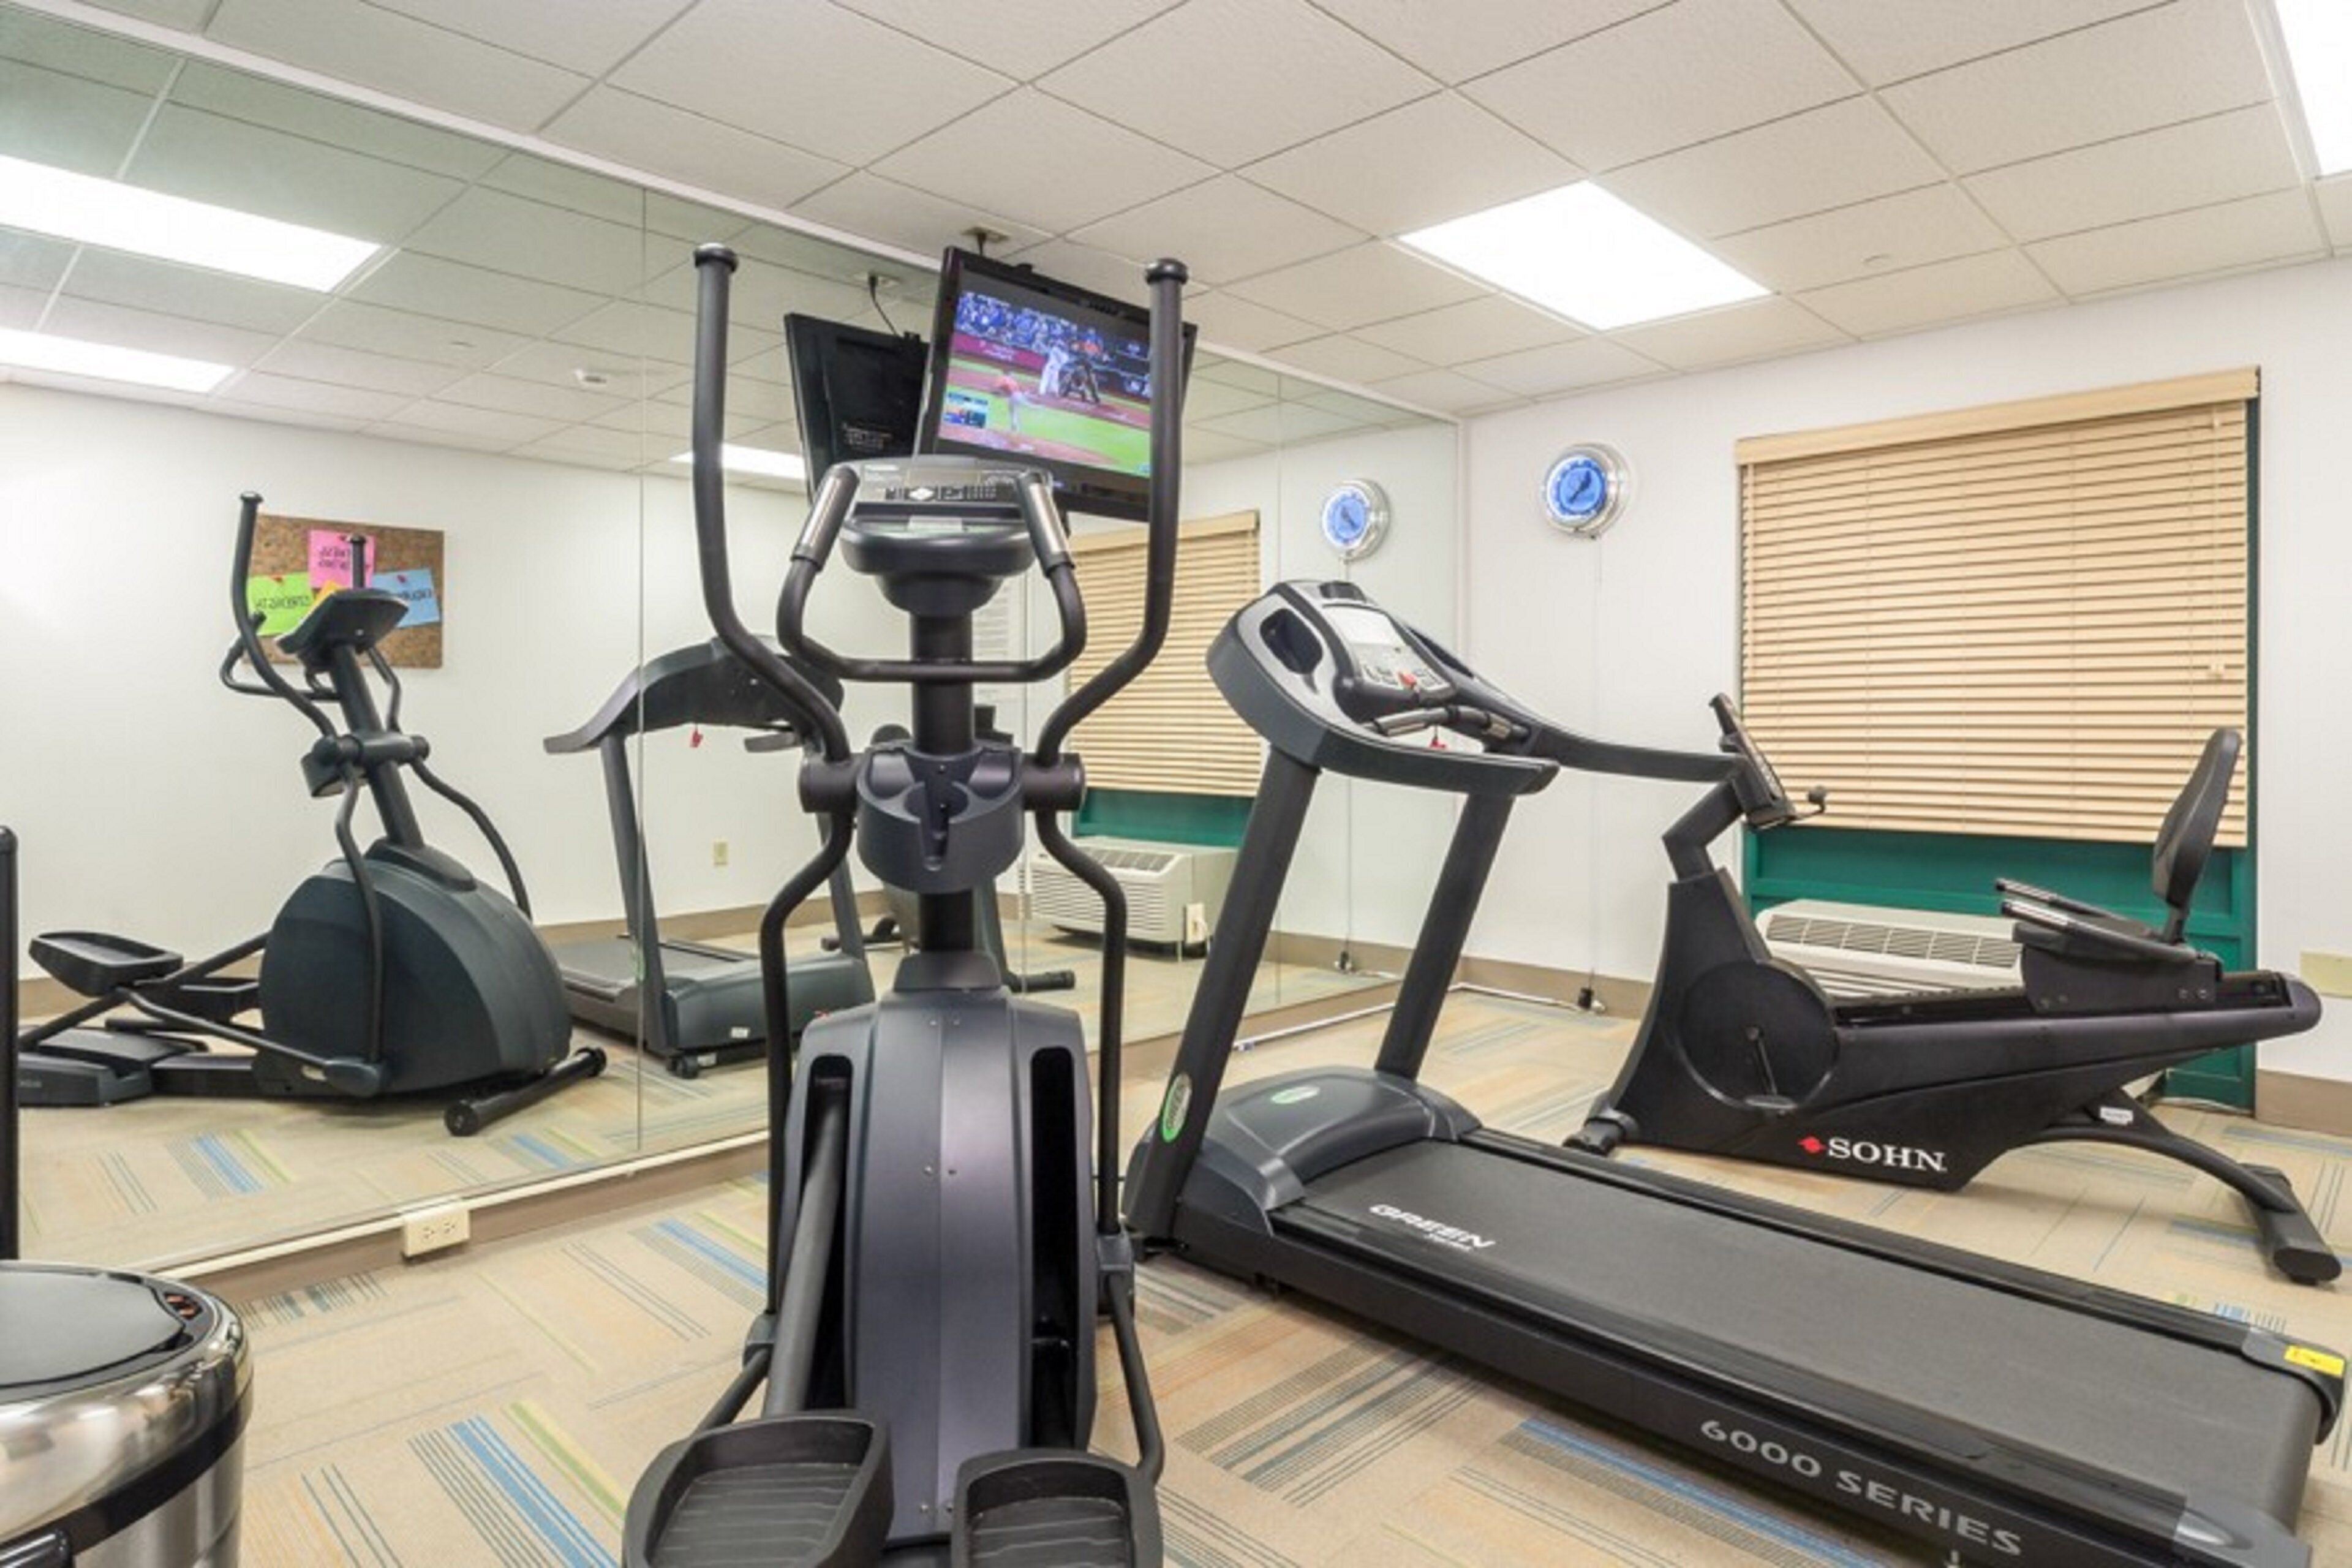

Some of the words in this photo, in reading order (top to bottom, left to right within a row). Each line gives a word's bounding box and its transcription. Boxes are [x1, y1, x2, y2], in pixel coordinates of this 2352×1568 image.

[1828, 1136, 1948, 1173] SOHN
[1369, 1204, 1496, 1248] GREEN
[1700, 1420, 1822, 1478] 6000
[1836, 1469, 2022, 1556] SERIES
